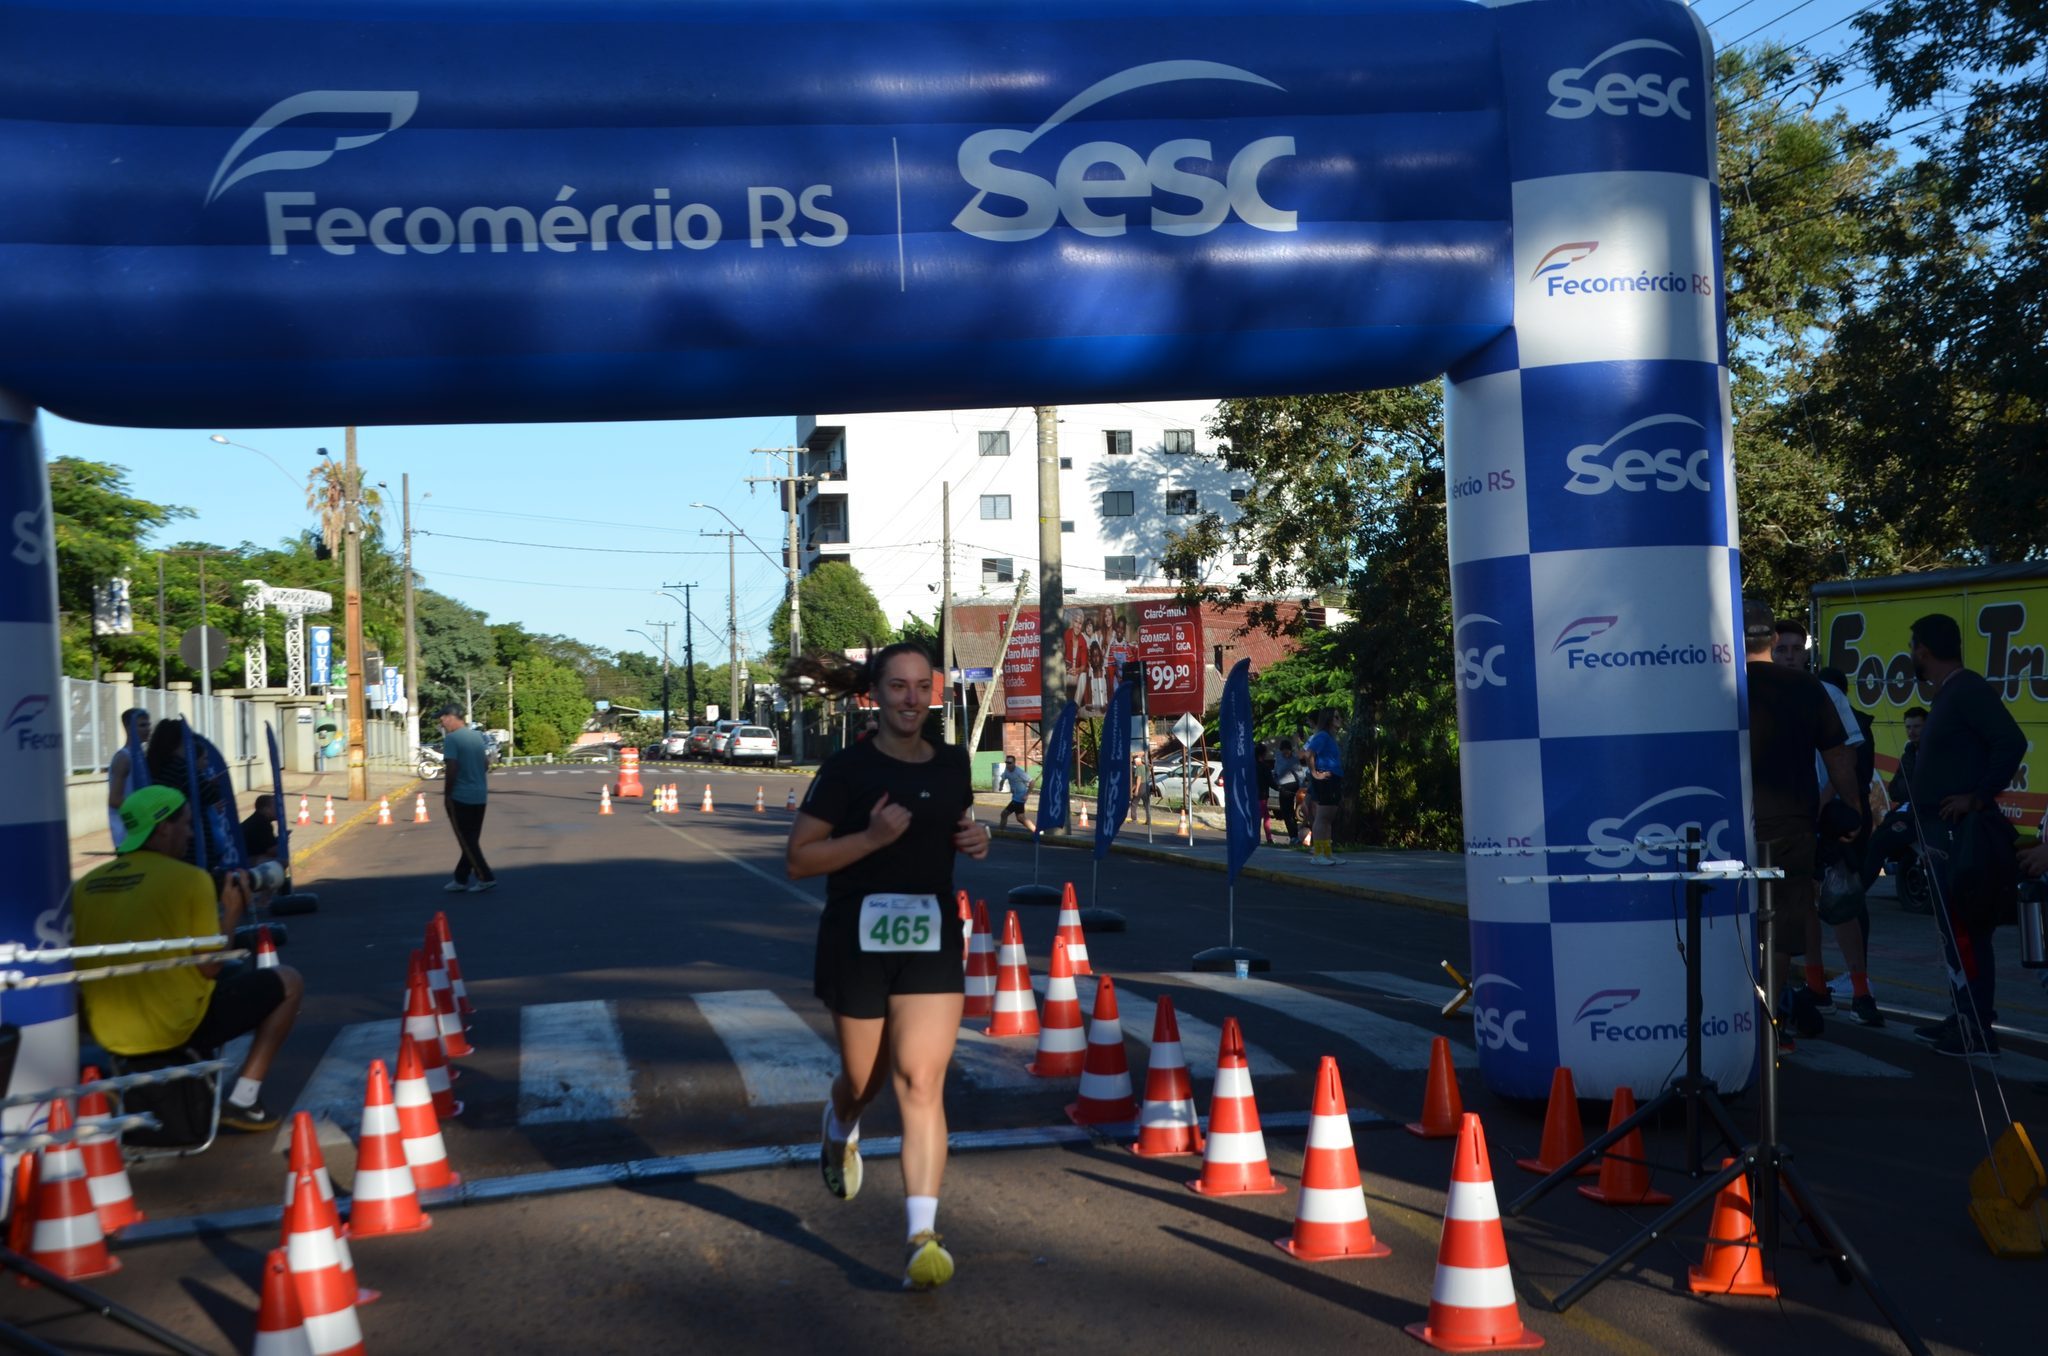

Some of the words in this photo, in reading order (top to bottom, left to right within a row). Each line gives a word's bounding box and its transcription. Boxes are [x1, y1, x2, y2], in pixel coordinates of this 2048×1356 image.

[265, 185, 722, 256] Fecomércio
[748, 184, 849, 249] RS
[1548, 271, 1686, 297] Fecomércio
[1692, 273, 1712, 296] RS
[1450, 475, 1483, 499] ércio
[1487, 469, 1515, 492] RS
[1141, 634, 1152, 643] 600
[1153, 633, 1170, 642] MEGA
[1176, 632, 1185, 640] 60
[1176, 642, 1191, 651] GIGA
[1455, 644, 1507, 690] esc
[1568, 644, 1707, 669] Fecomércio
[1712, 643, 1732, 664] RS
[1830, 611, 1934, 707] Foo
[870, 915, 930, 945] 465
[1475, 1009, 1529, 1052] esc
[1590, 1015, 1728, 1042] Fecomécio
[1734, 1011, 1752, 1033] RS
